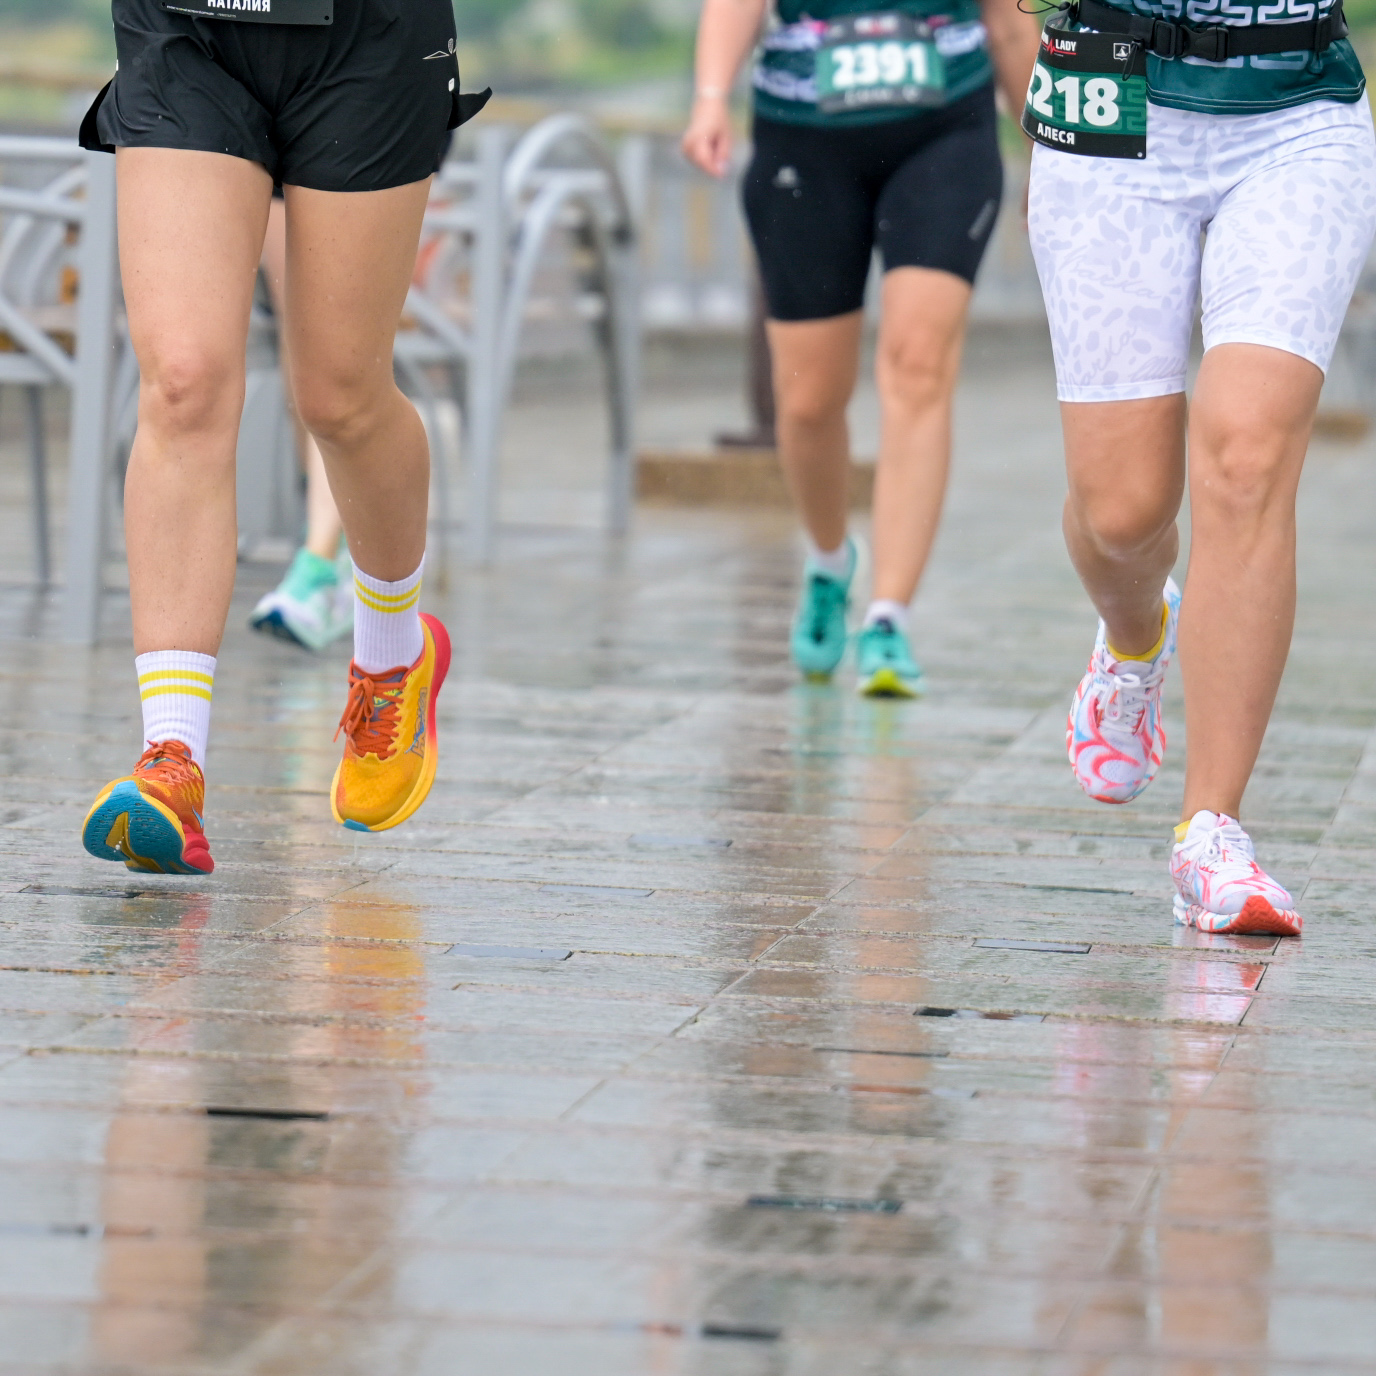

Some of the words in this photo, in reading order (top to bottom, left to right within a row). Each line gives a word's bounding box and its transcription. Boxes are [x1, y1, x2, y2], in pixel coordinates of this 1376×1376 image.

[1055, 38, 1077, 52] LADY
[831, 42, 928, 89] 2391
[1027, 62, 1119, 127] 218
[1037, 122, 1076, 145] АЛЕСЯ
